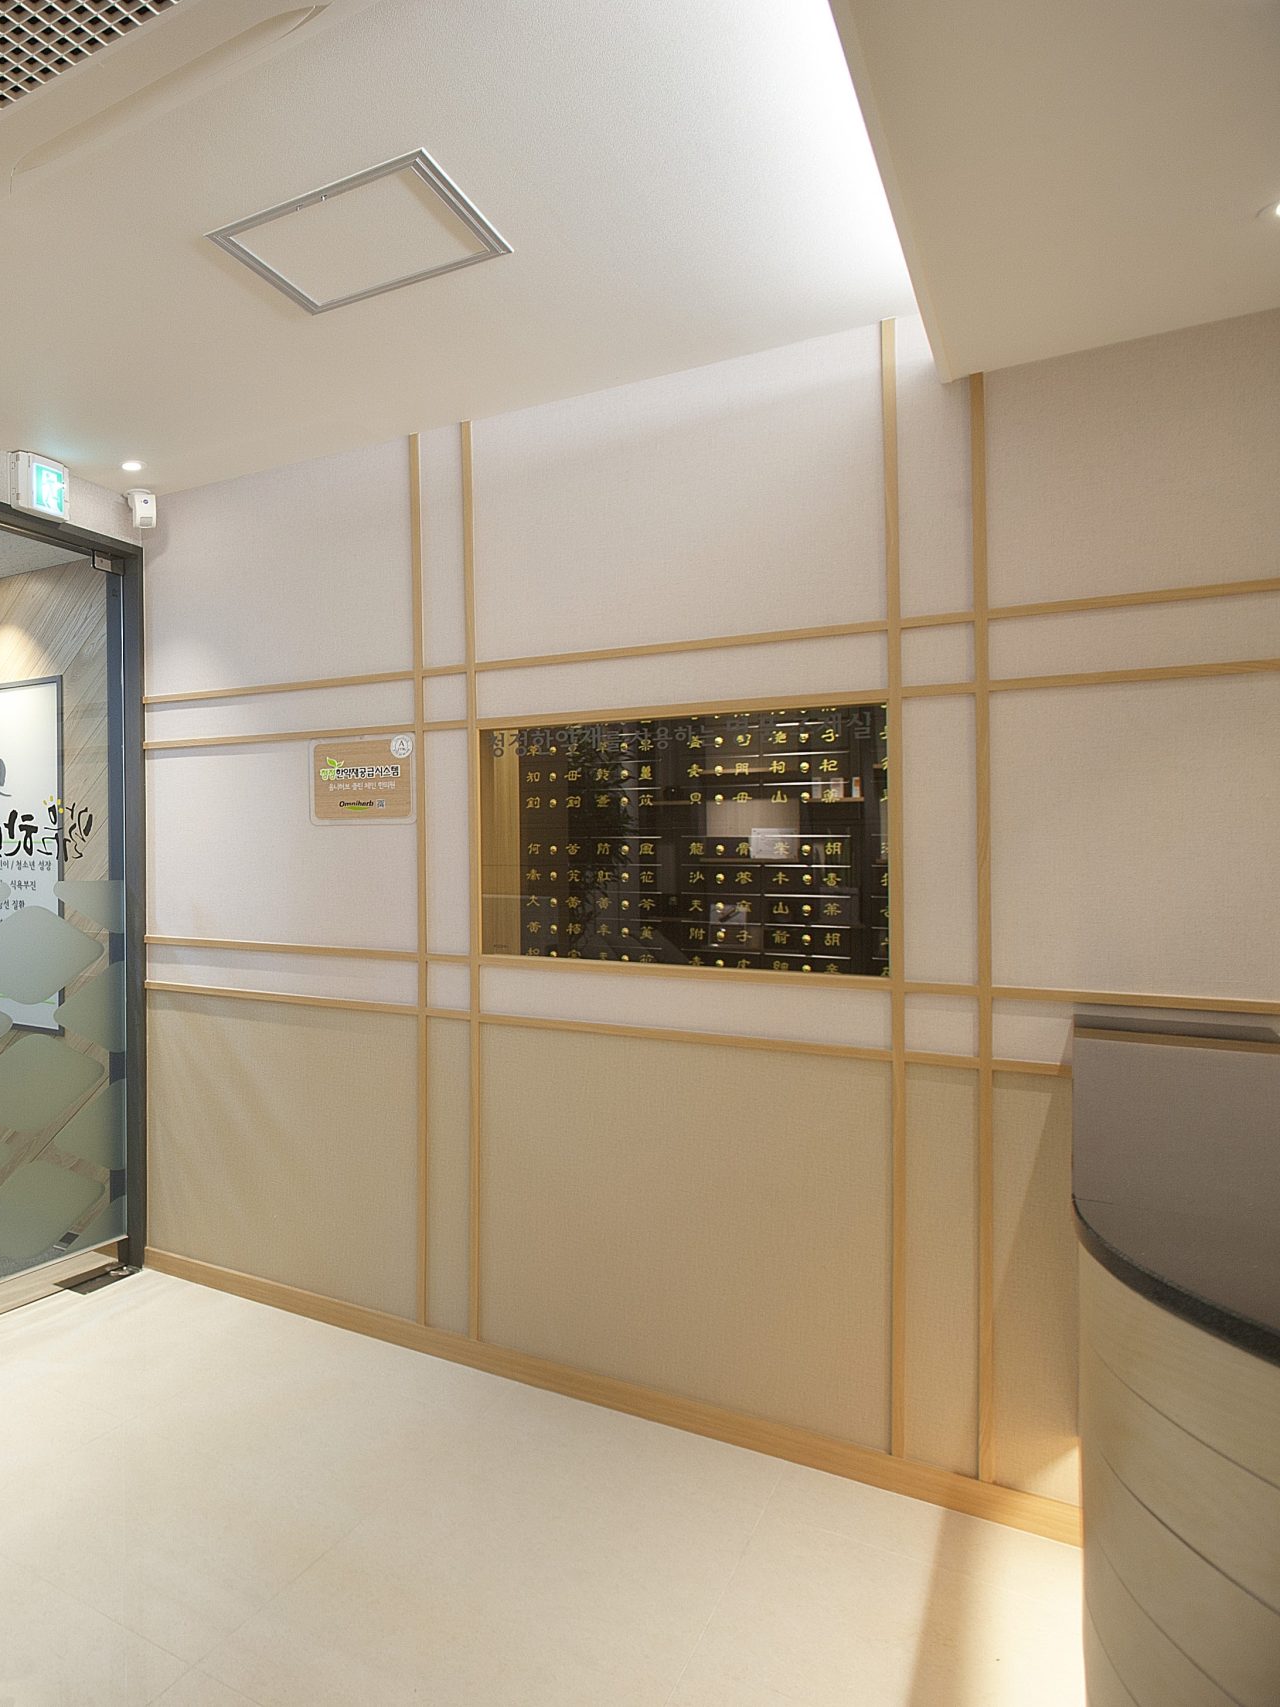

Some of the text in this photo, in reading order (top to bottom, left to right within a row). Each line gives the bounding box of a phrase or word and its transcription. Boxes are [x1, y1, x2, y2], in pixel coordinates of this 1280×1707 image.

[16, 861, 35, 870] 청소년
[38, 862, 52, 871] 성장
[10, 880, 37, 891] 식욕부진
